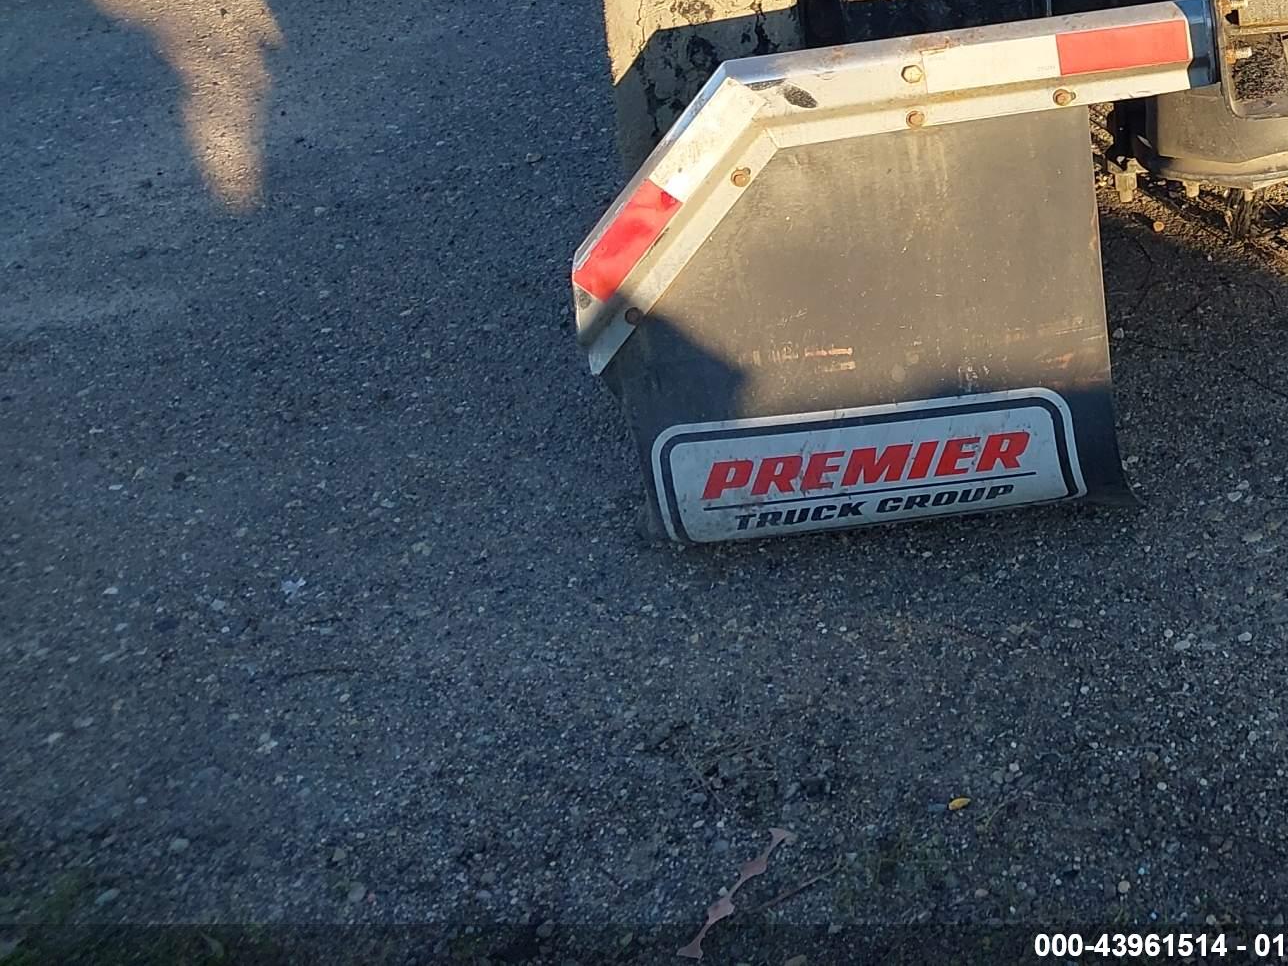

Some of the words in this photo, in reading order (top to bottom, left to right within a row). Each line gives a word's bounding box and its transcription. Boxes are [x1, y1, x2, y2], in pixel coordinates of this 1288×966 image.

[702, 431, 1031, 500] PREMIER
[736, 500, 867, 531] TRUCK
[876, 484, 1014, 515] GROUP
